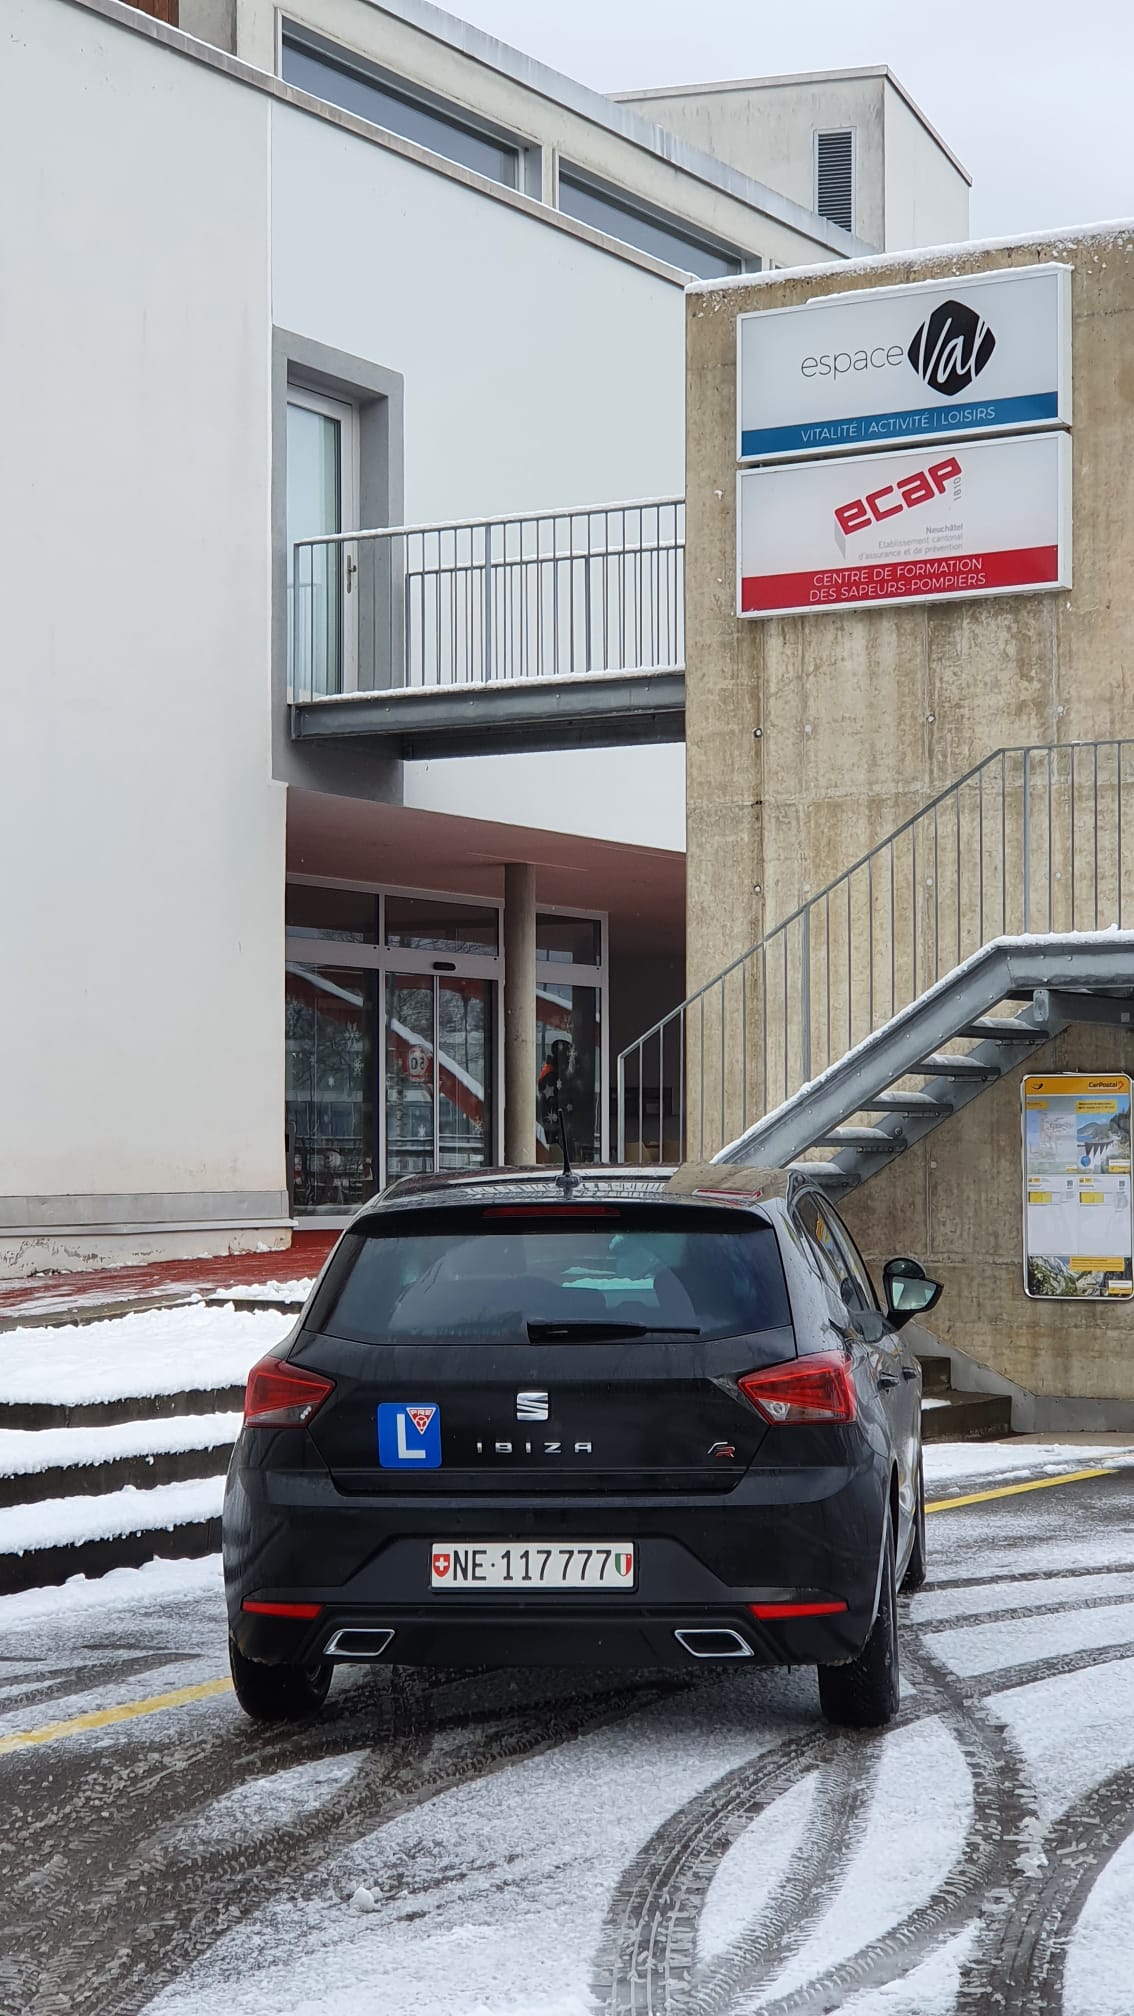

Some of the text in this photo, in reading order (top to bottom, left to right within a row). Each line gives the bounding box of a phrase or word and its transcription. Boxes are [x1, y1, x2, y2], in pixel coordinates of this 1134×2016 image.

[800, 315, 990, 385] espace Val
[801, 406, 996, 442] VITALITÉ ACTIVITÉ LOISIRS
[925, 523, 964, 536] Neuchâtel
[932, 533, 963, 544] cantonal
[858, 543, 963, 561] d'assurance et de prévention
[813, 558, 983, 587] CENTRE DE FORMATION
[809, 572, 987, 602] DES SAPEURS-POMPIERS
[1088, 1080, 1118, 1089] CarPostal
[396, 1413, 427, 1459] L
[476, 1442, 592, 1453] IBIZA
